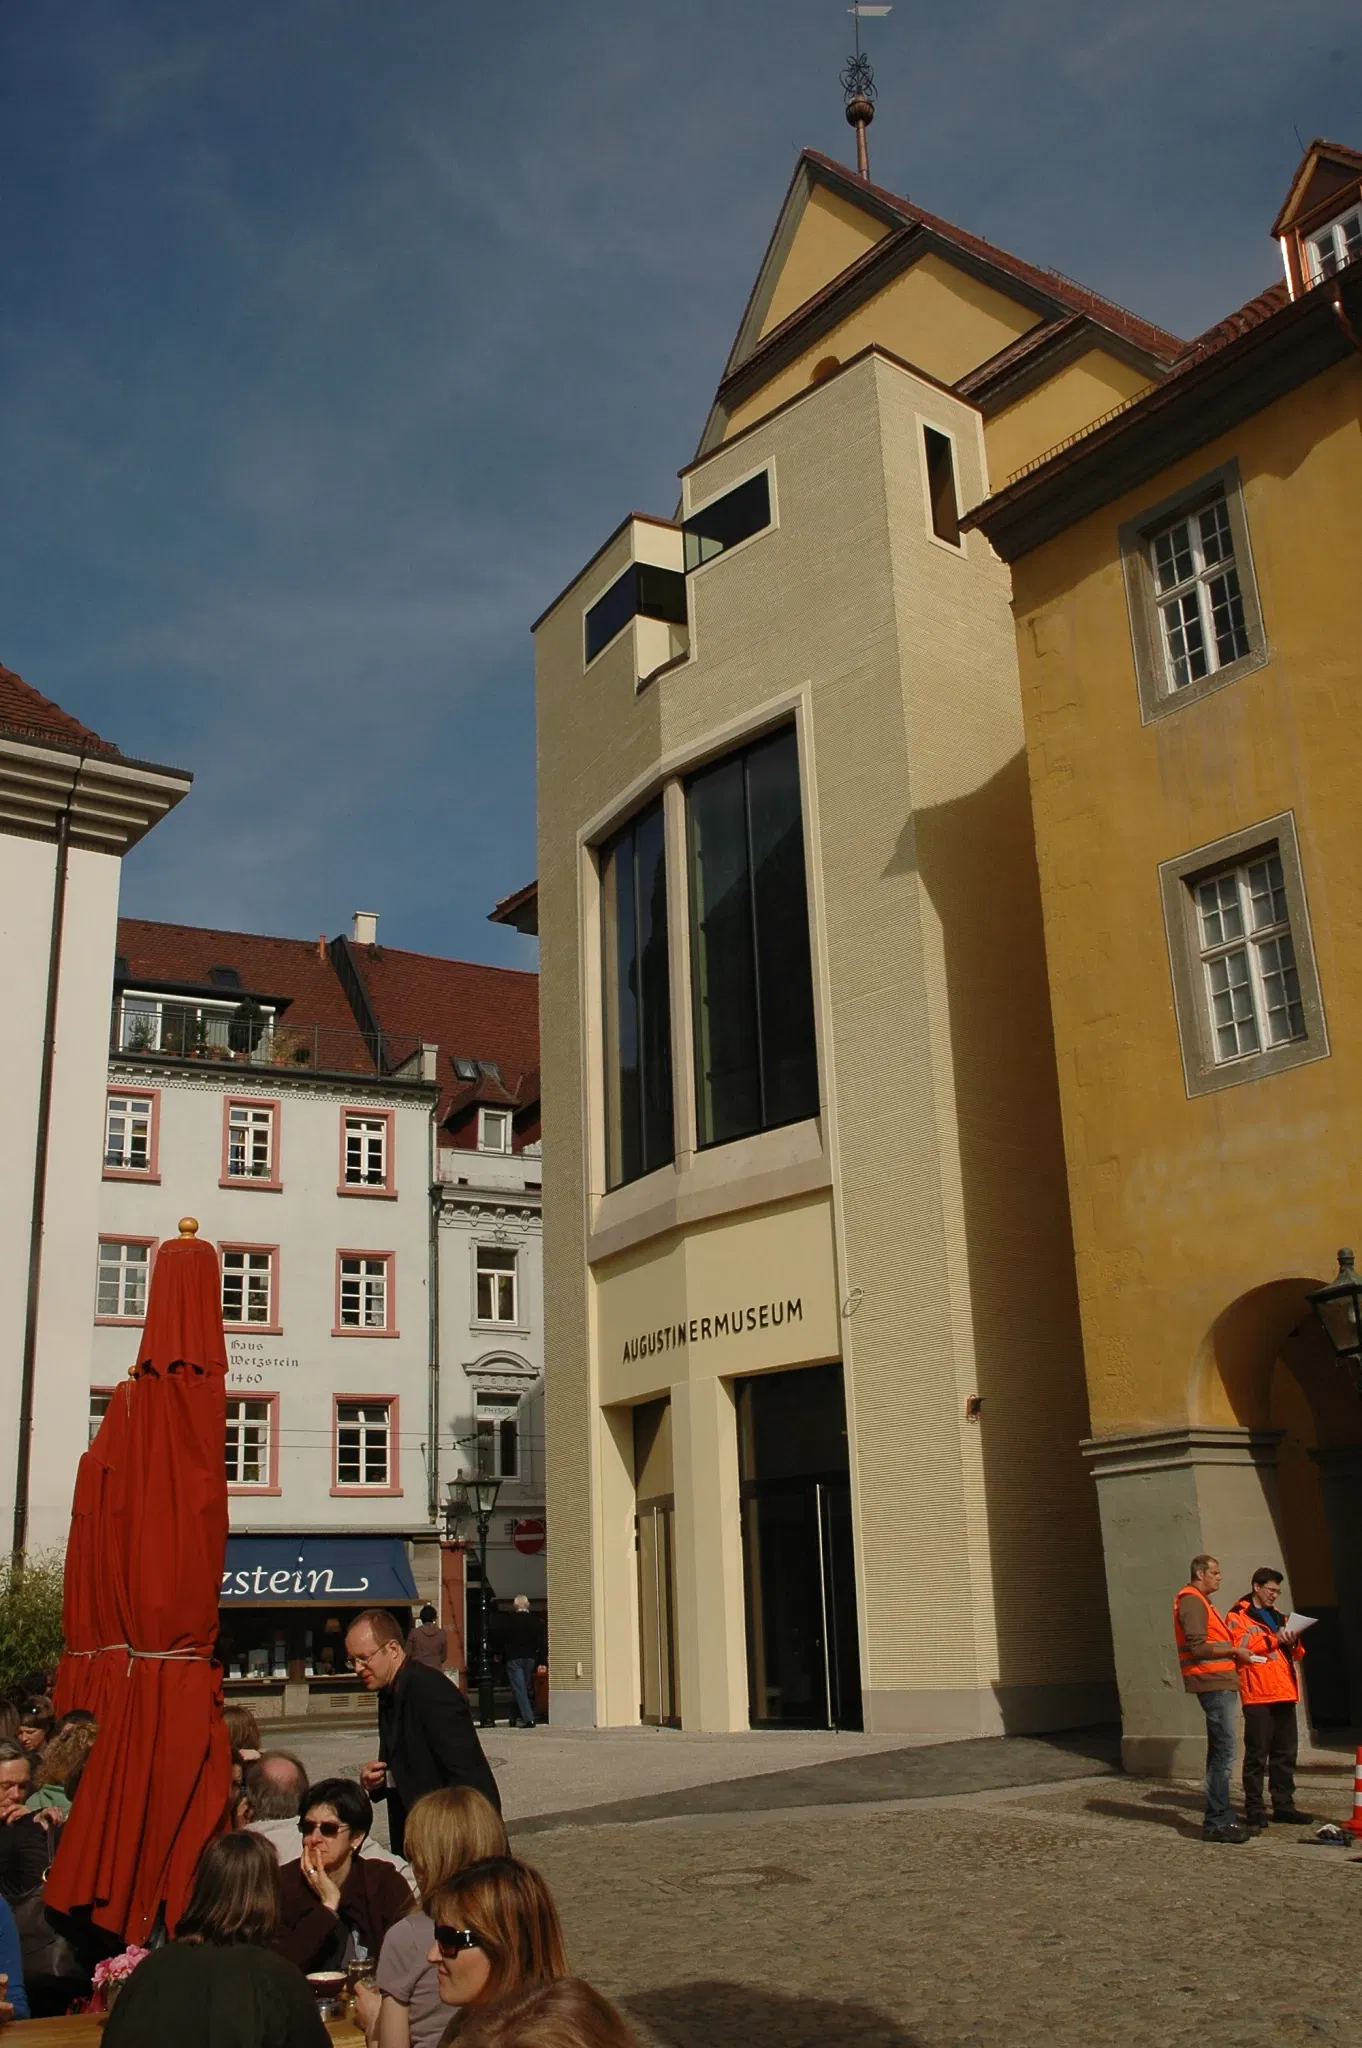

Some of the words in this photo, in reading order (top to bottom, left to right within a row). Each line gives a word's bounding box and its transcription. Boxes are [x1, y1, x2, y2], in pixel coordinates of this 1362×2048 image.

[622, 1297, 803, 1365] AUGUSTINERMUSEUM
[231, 1339, 264, 1351] Haus
[230, 1354, 299, 1368] Wetzstein
[231, 1373, 263, 1384] 1460
